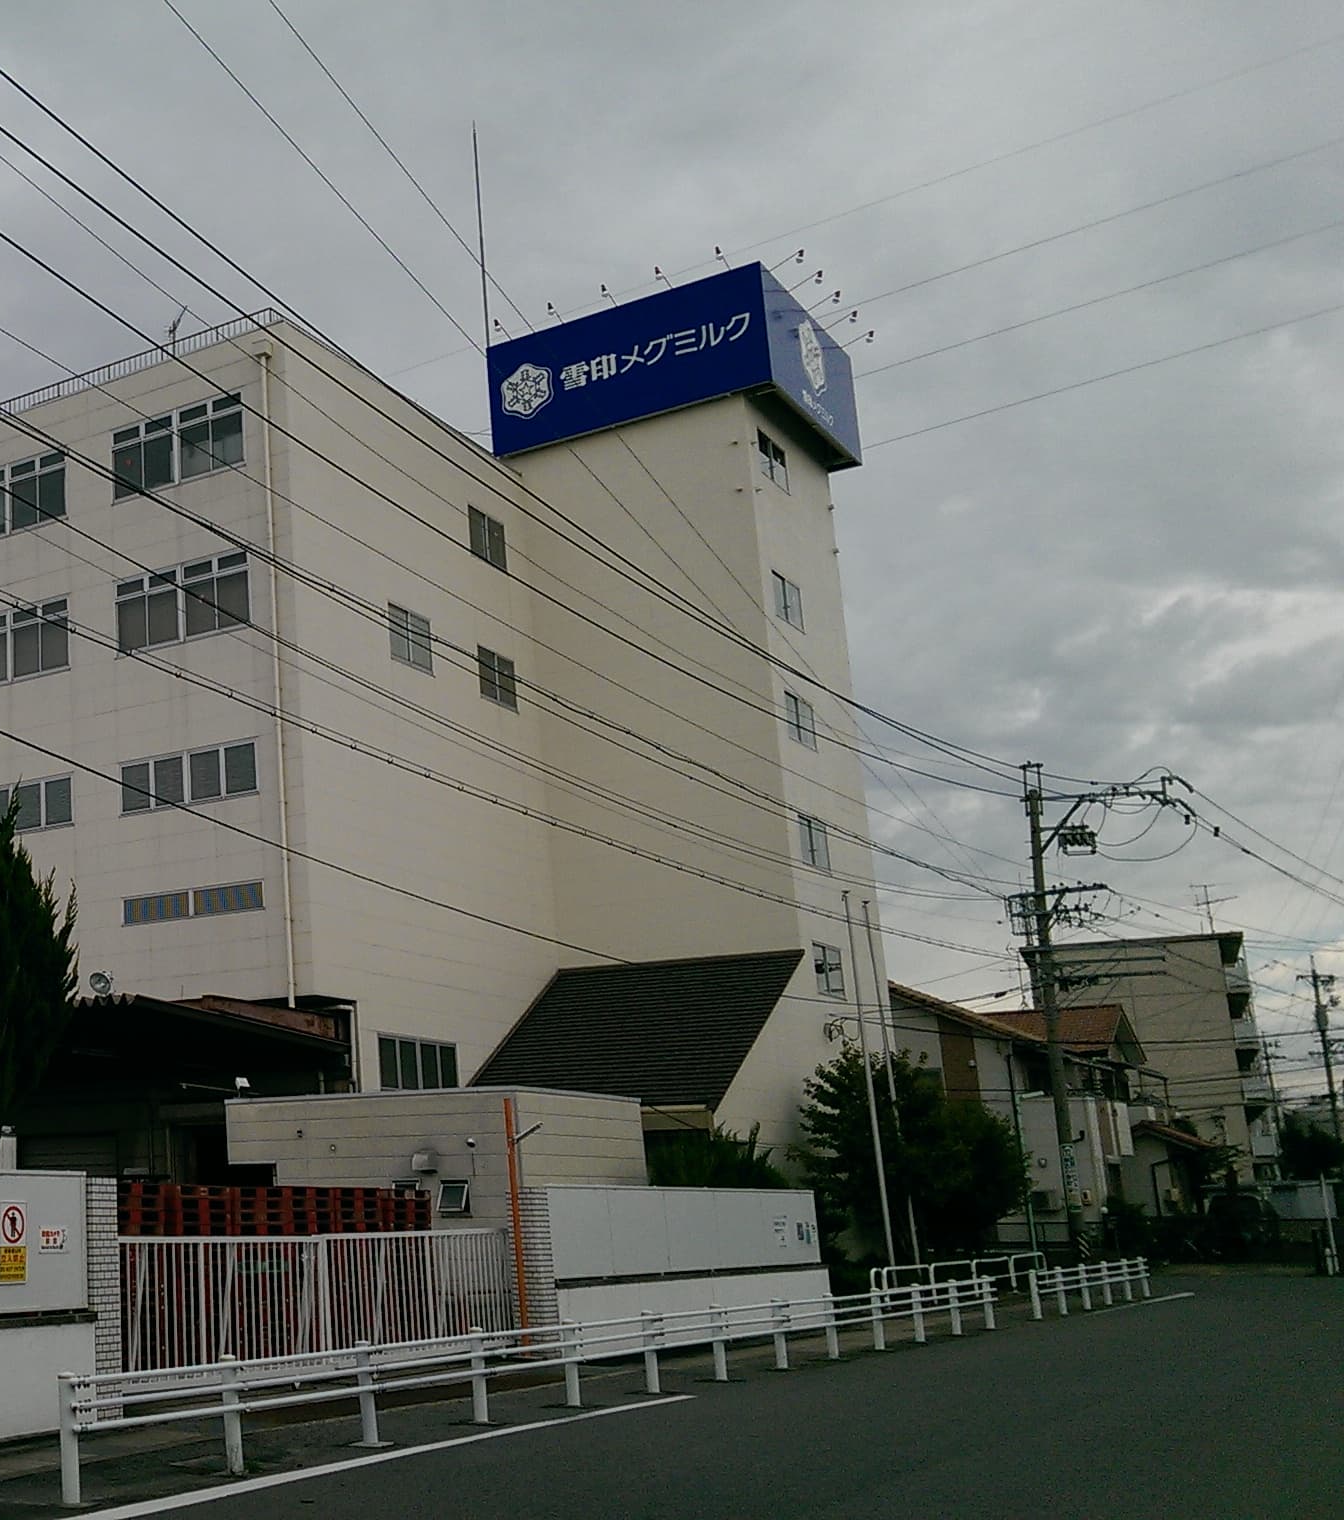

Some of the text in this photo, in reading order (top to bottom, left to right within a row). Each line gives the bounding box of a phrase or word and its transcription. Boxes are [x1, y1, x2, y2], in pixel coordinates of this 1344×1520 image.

[559, 312, 751, 391] 雪印メグミルク
